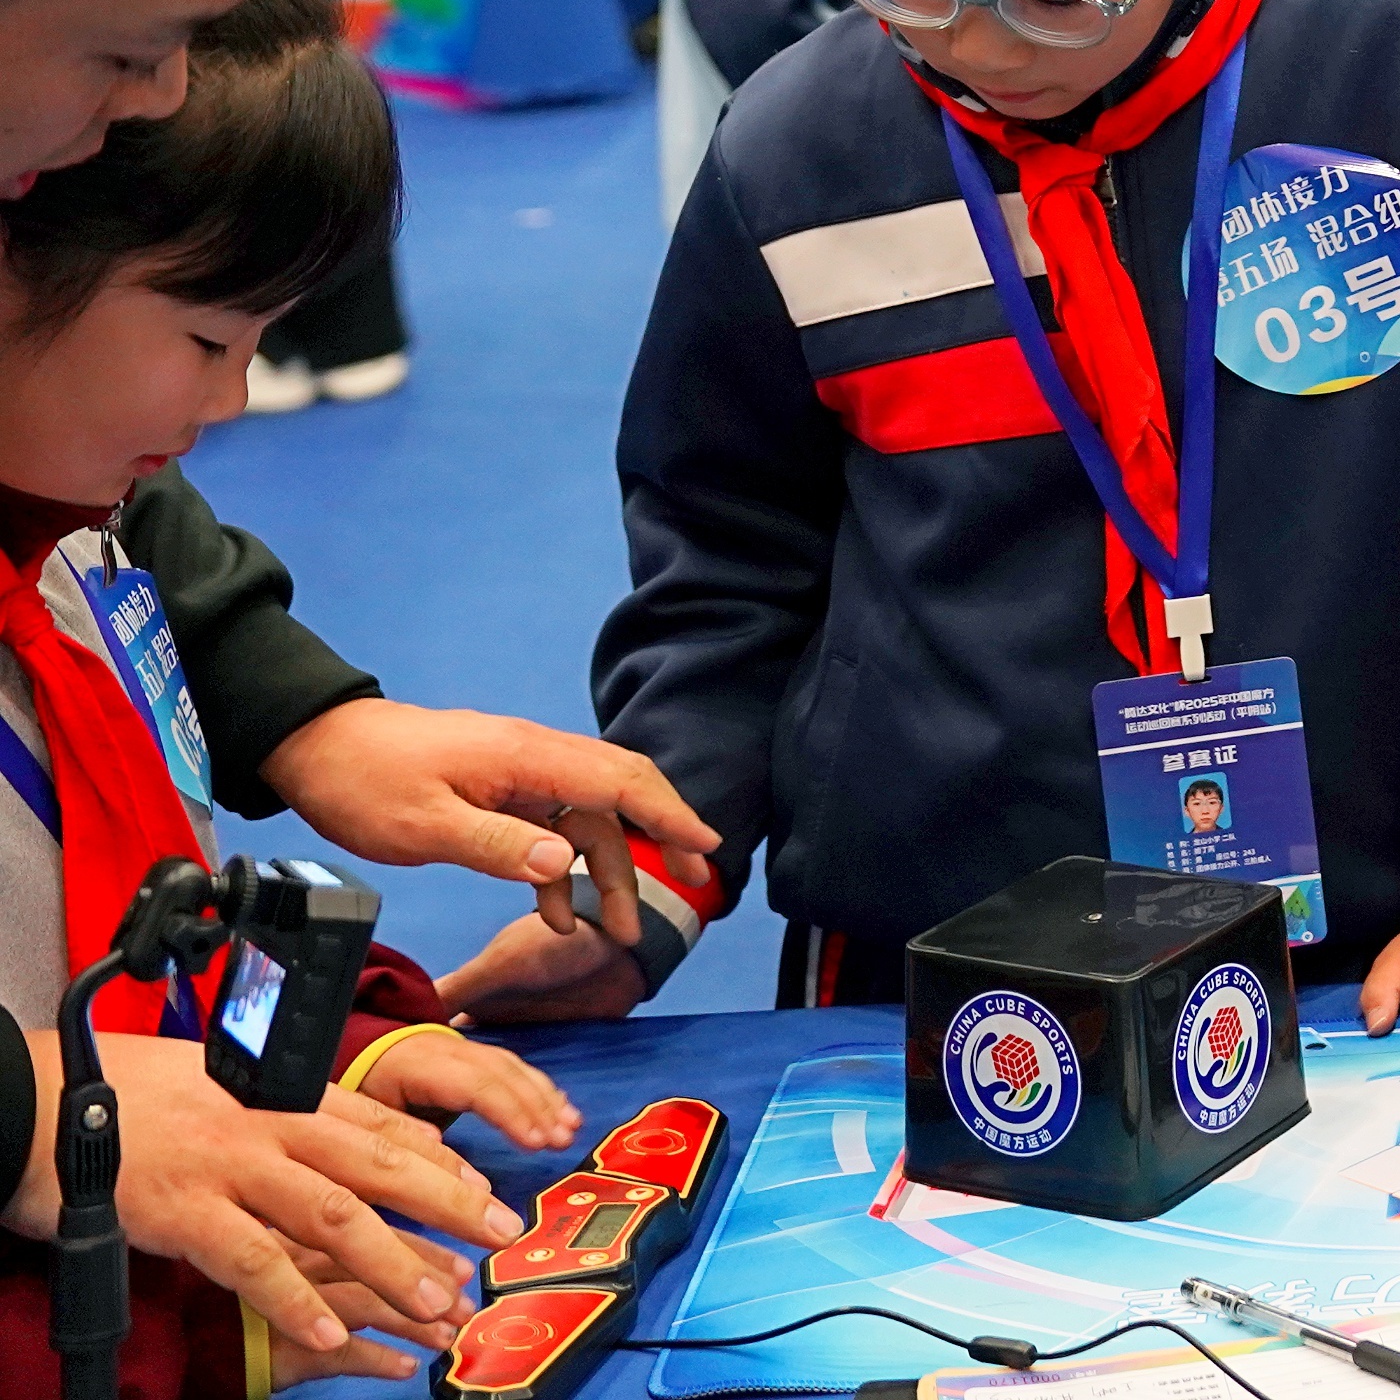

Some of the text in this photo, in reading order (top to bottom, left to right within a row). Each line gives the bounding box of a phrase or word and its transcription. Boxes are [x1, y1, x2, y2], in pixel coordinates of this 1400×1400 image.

[1221, 166, 1350, 244] 团体接力
[108, 582, 156, 647] 团体接力
[135, 649, 166, 707] 五场
[1162, 745, 1238, 773] 参赛证
[950, 998, 1074, 1075] CHINA CUBE SPORTS
[1178, 971, 1265, 1061] CHINA CUBE SPORTS
[973, 1115, 1052, 1151] 中国魔方运动
[1199, 1082, 1256, 1127] 中国魔方运动
